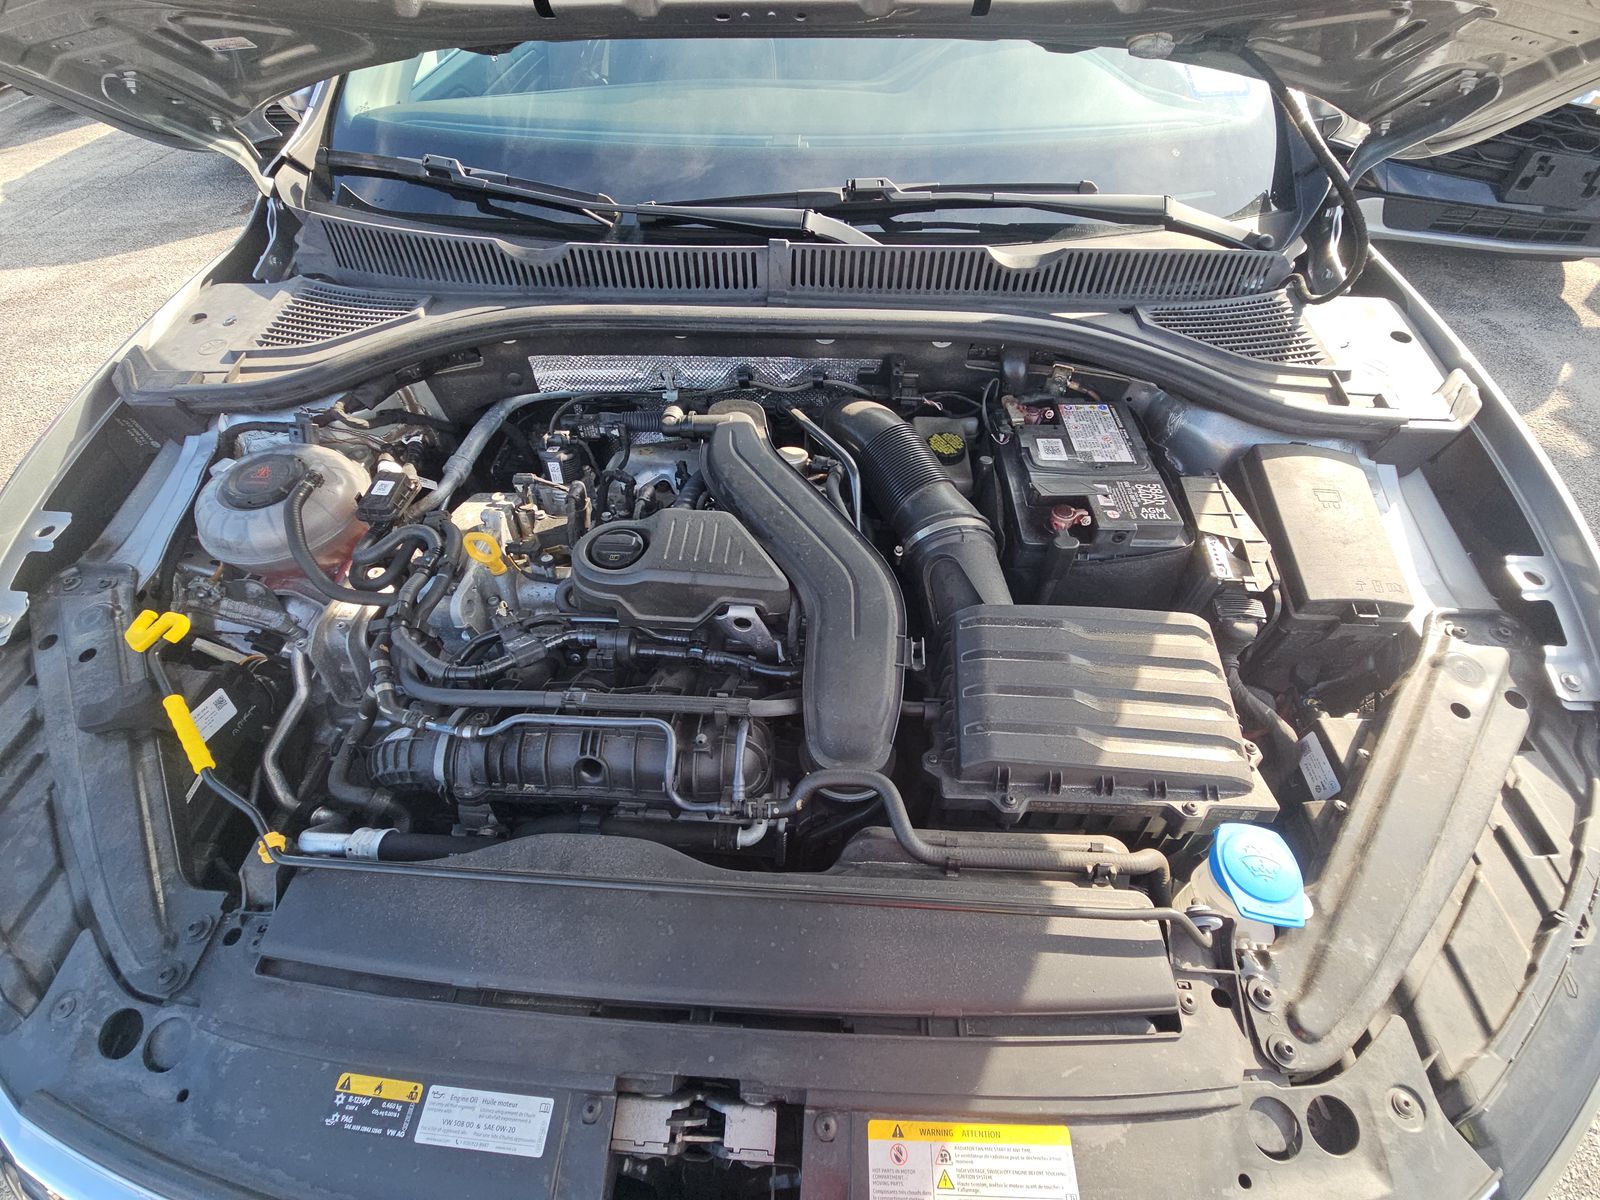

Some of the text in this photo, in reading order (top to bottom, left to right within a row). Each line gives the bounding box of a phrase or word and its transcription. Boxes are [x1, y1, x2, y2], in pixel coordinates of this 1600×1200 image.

[1135, 484, 1156, 505] 640A
[1148, 484, 1168, 506] 58Ah
[450, 1094, 469, 1103] Engine
[341, 1114, 353, 1123] PAG
[496, 1125, 516, 1134] 0W-20
[919, 1128, 1000, 1138] WARNING ATTENTION
